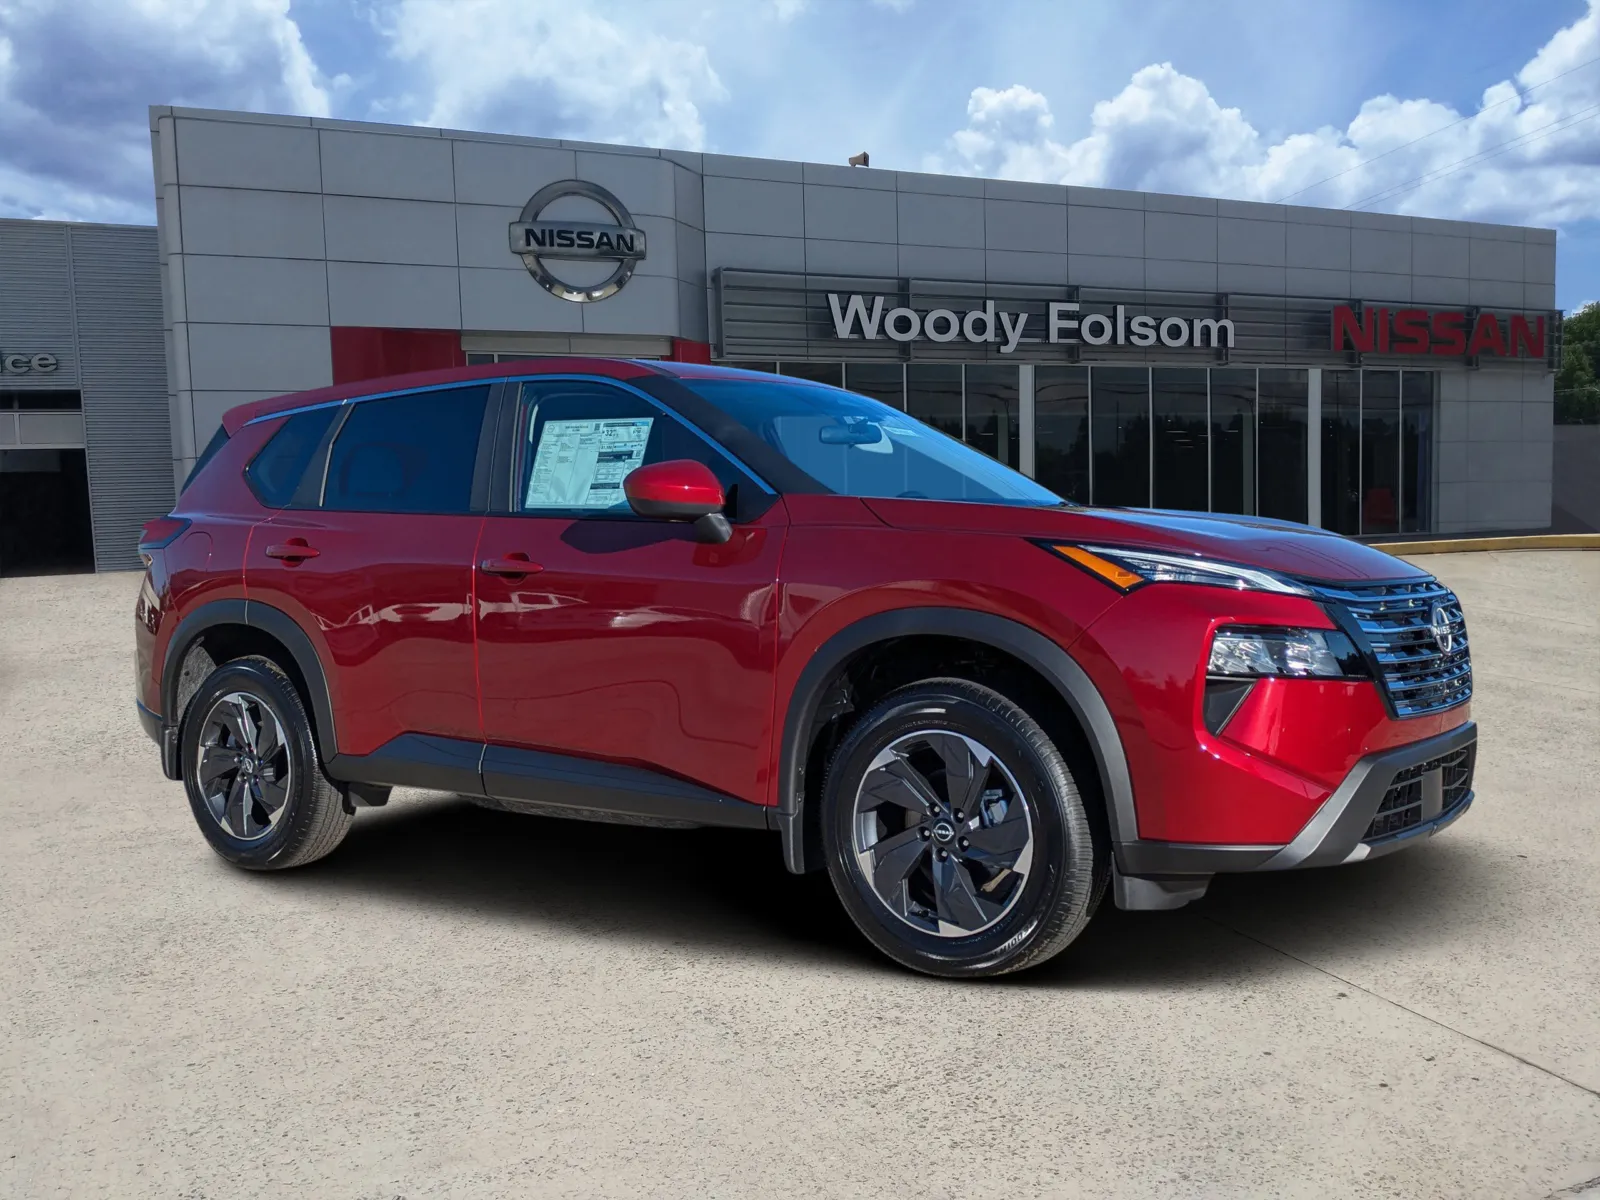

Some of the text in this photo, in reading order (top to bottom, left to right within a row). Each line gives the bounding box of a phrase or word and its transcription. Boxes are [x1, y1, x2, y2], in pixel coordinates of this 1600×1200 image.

[525, 228, 634, 252] NISSAN
[827, 293, 1236, 354] Woody Folsom
[1333, 304, 1545, 359] NISSAN
[0, 353, 57, 374] ce
